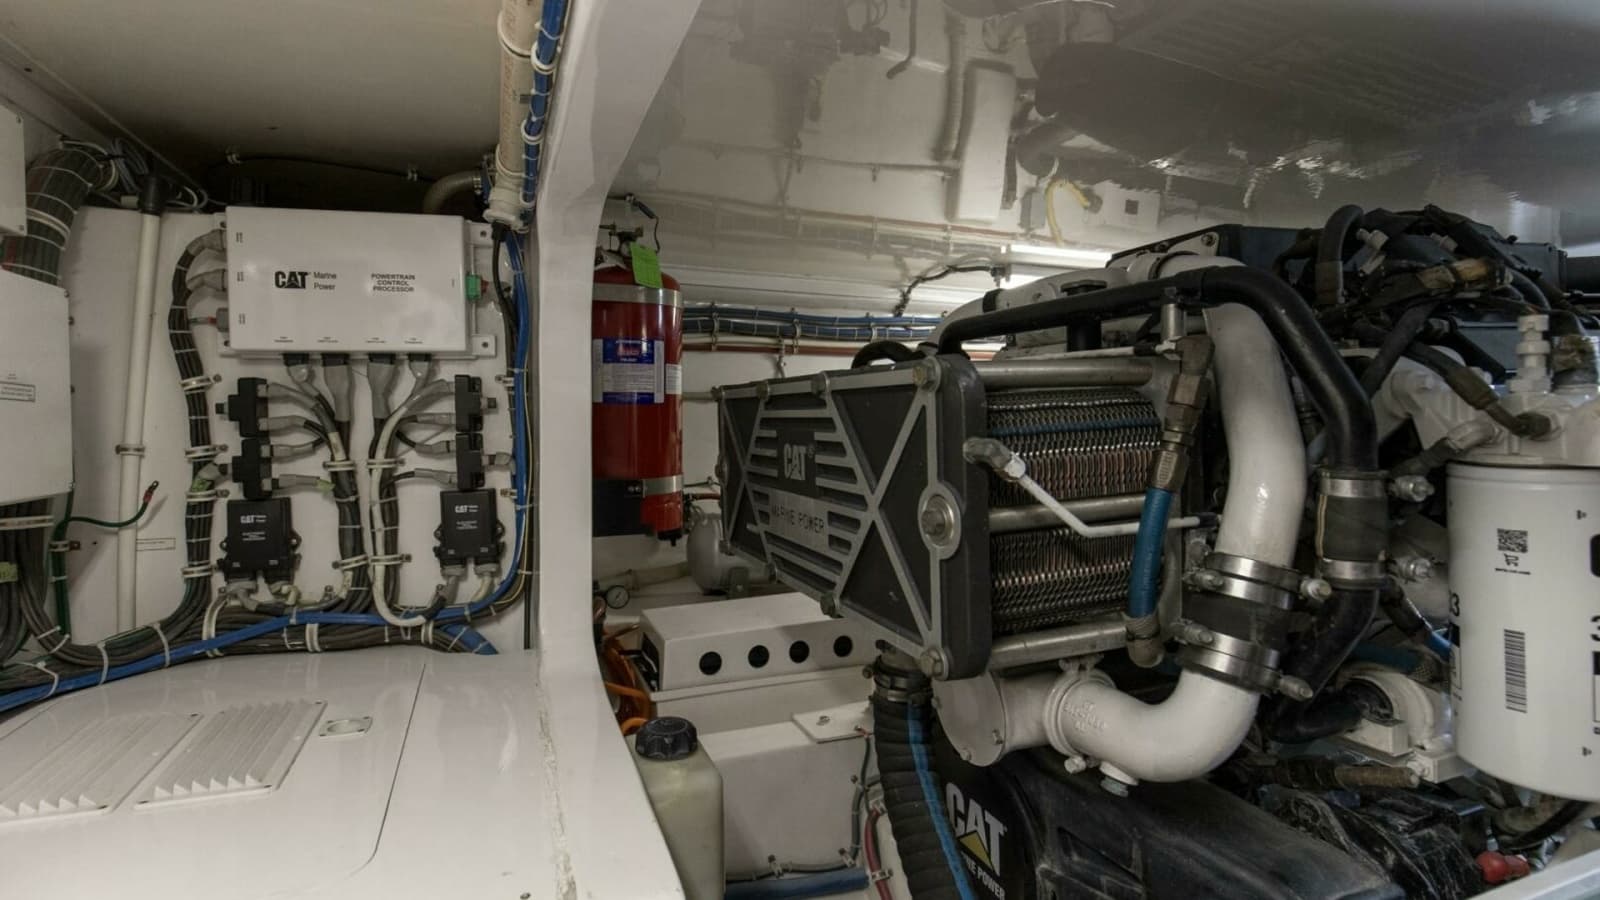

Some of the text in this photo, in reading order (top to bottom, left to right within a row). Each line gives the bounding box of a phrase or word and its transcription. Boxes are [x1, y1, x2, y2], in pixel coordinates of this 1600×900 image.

[275, 270, 337, 289] CAT Marine
[313, 282, 336, 291] Power
[783, 443, 807, 481] CAT
[771, 503, 825, 535] MARINE POWER
[945, 782, 1005, 877] CAT
[977, 866, 1006, 900] POWER
